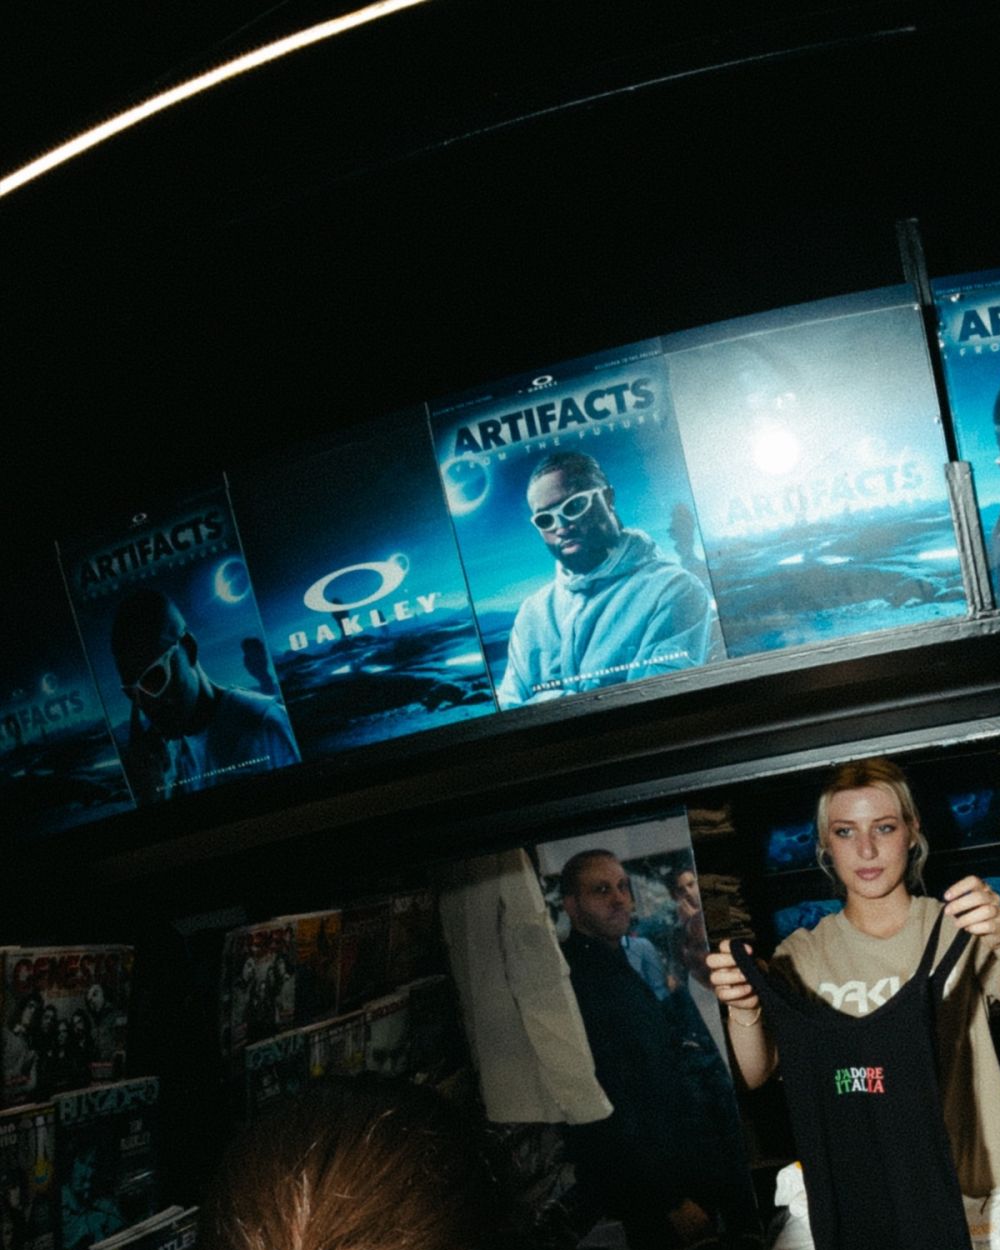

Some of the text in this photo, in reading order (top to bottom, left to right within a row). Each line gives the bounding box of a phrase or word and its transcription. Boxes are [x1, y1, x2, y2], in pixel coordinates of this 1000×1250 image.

[455, 377, 655, 456] ARTIFACTS
[525, 437, 561, 454] THE
[79, 511, 222, 582] ARTIFACTS
[288, 592, 437, 652] OAKLEY
[836, 1079, 884, 1095] ITALIA
